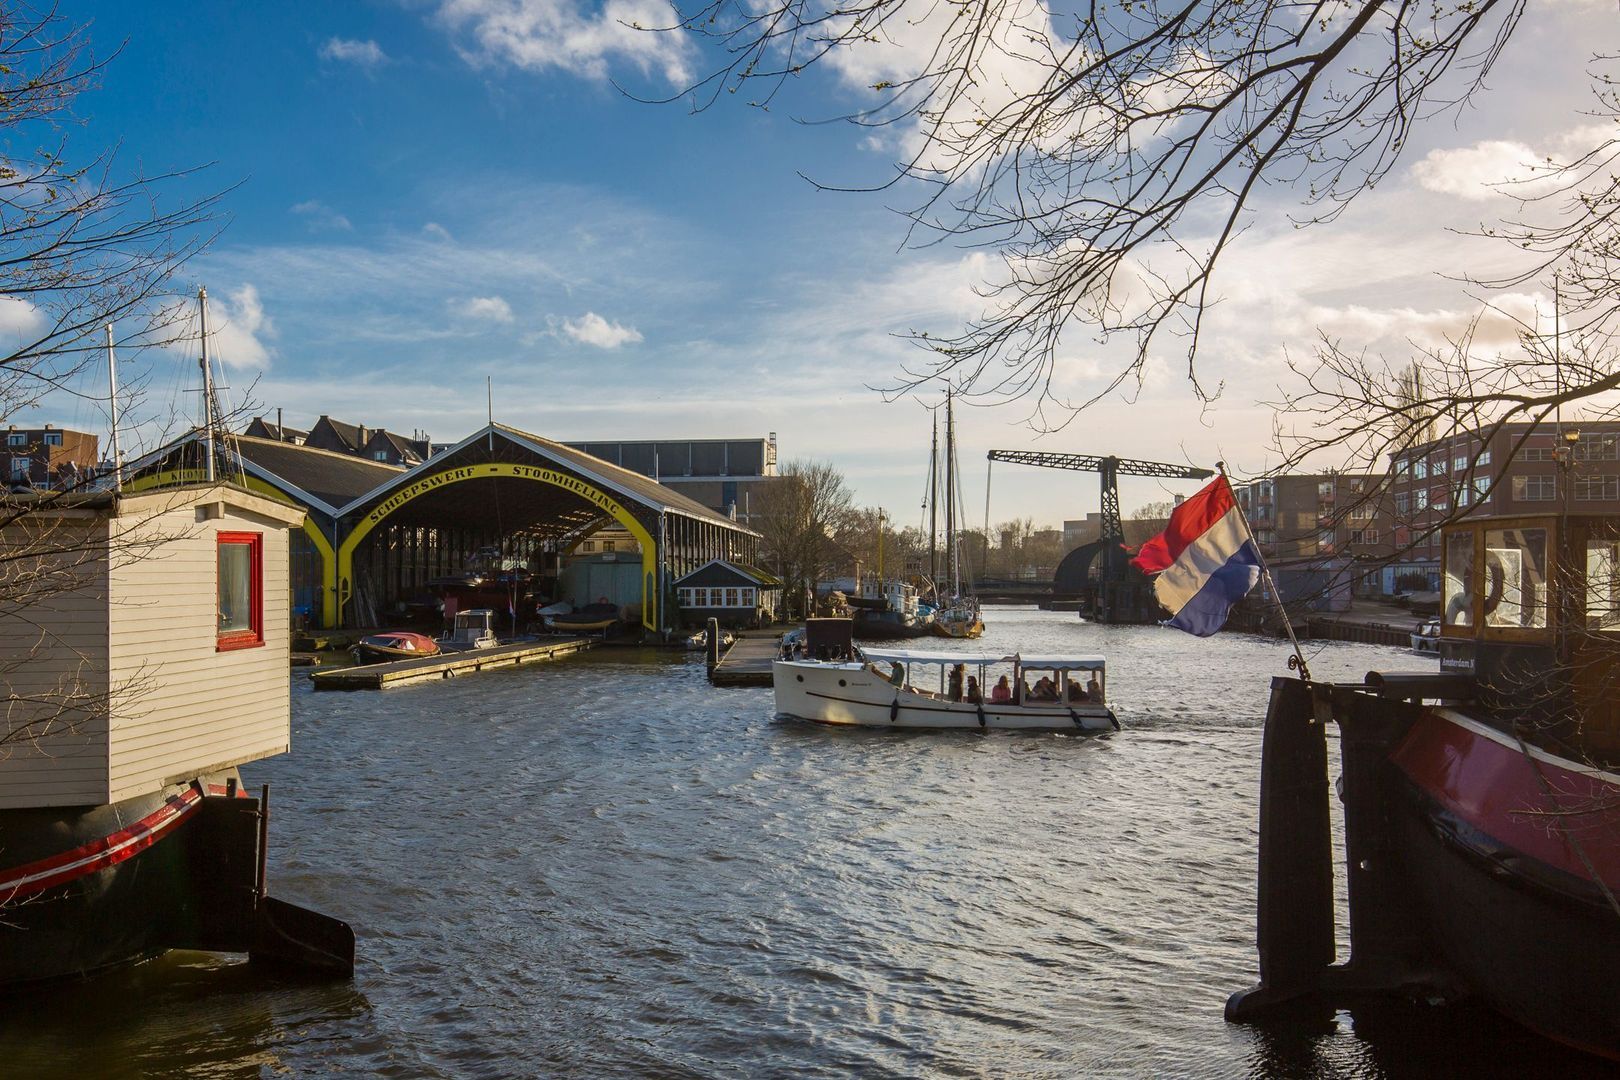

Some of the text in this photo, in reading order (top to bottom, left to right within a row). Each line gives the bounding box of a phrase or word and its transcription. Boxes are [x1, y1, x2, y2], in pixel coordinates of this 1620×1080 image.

[370, 467, 475, 523] SCHEEPSWERF
[512, 466, 620, 514] STOOMHELLING
[1441, 657, 1470, 668] Amsterdam
